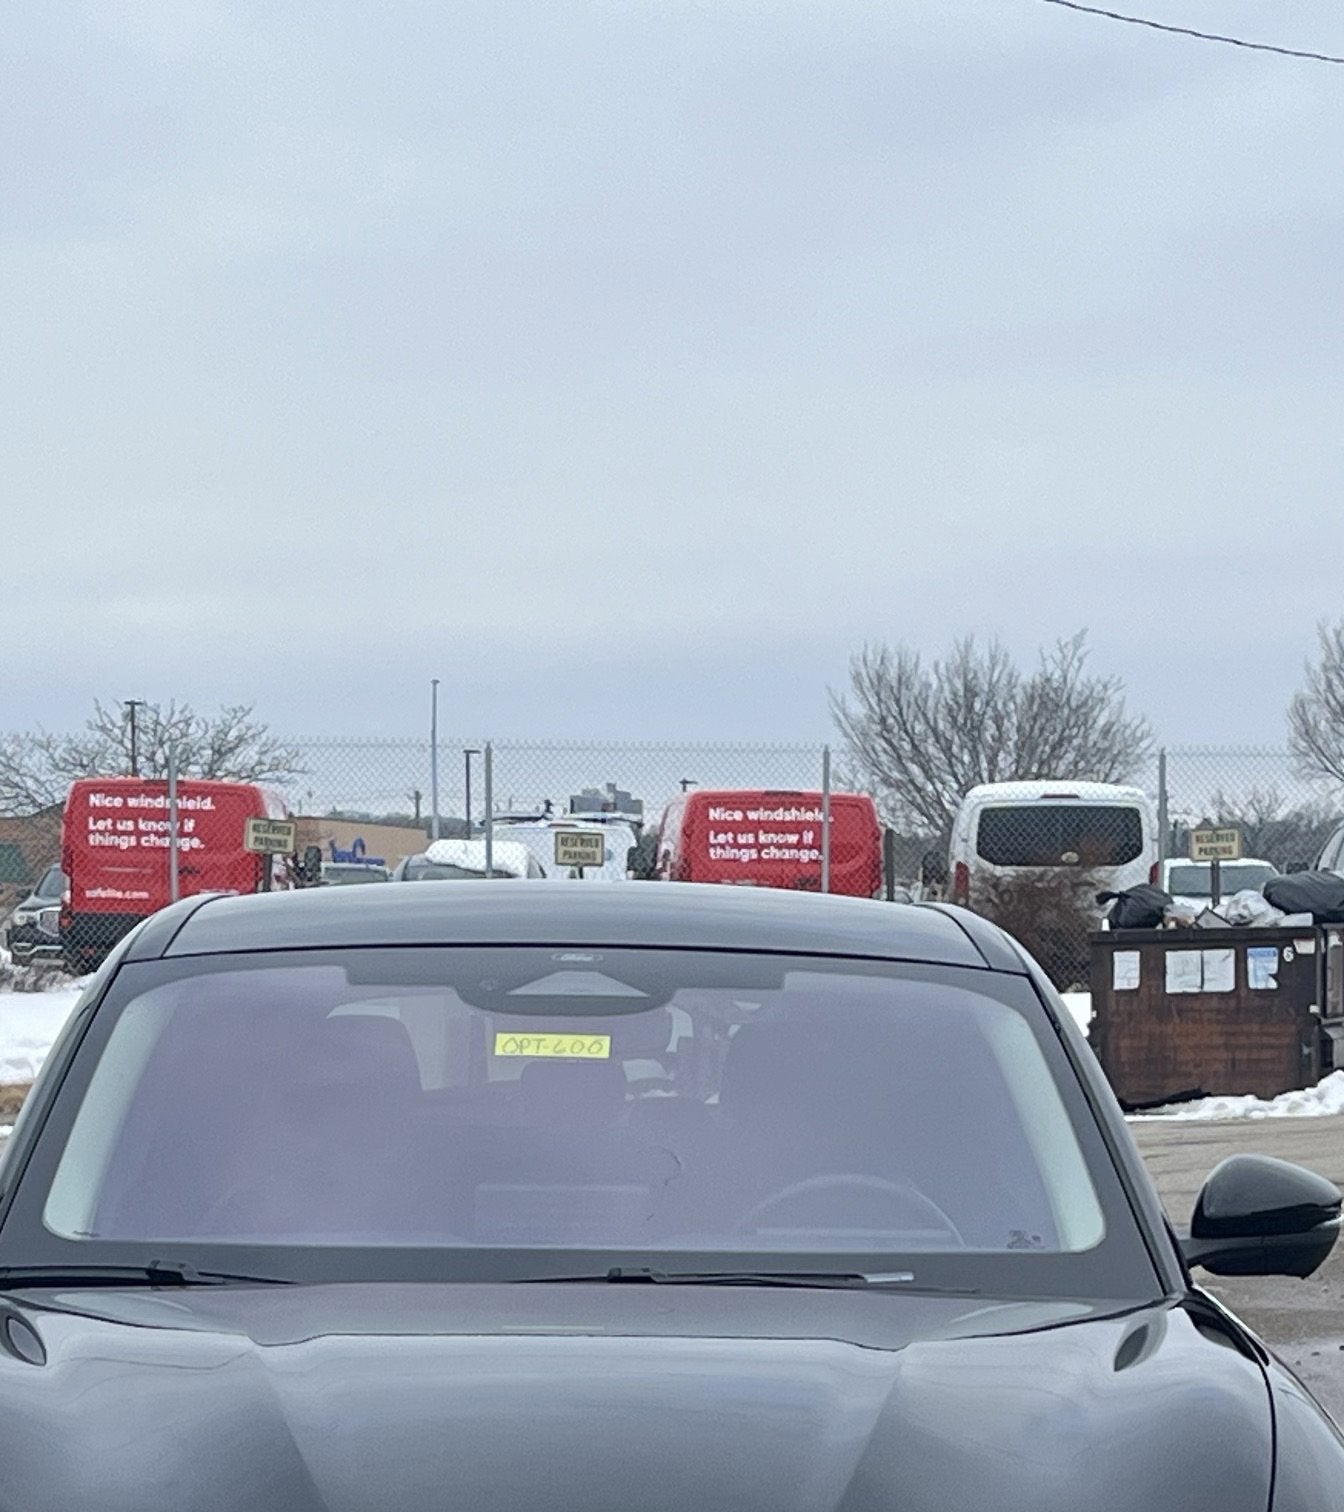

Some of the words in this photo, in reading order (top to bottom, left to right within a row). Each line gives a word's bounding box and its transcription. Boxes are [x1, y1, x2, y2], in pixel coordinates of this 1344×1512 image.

[89, 793, 123, 807] Nice
[709, 808, 743, 821] Nice
[88, 816, 113, 830] Let
[117, 819, 134, 831] us
[184, 818, 195, 832] if
[88, 832, 136, 849] things
[709, 830, 734, 844] Let
[737, 832, 755, 844] us
[759, 830, 799, 844] know
[802, 830, 814, 845] if
[709, 846, 758, 863] things
[761, 846, 824, 863] change.
[1283, 946, 1294, 962] 6
